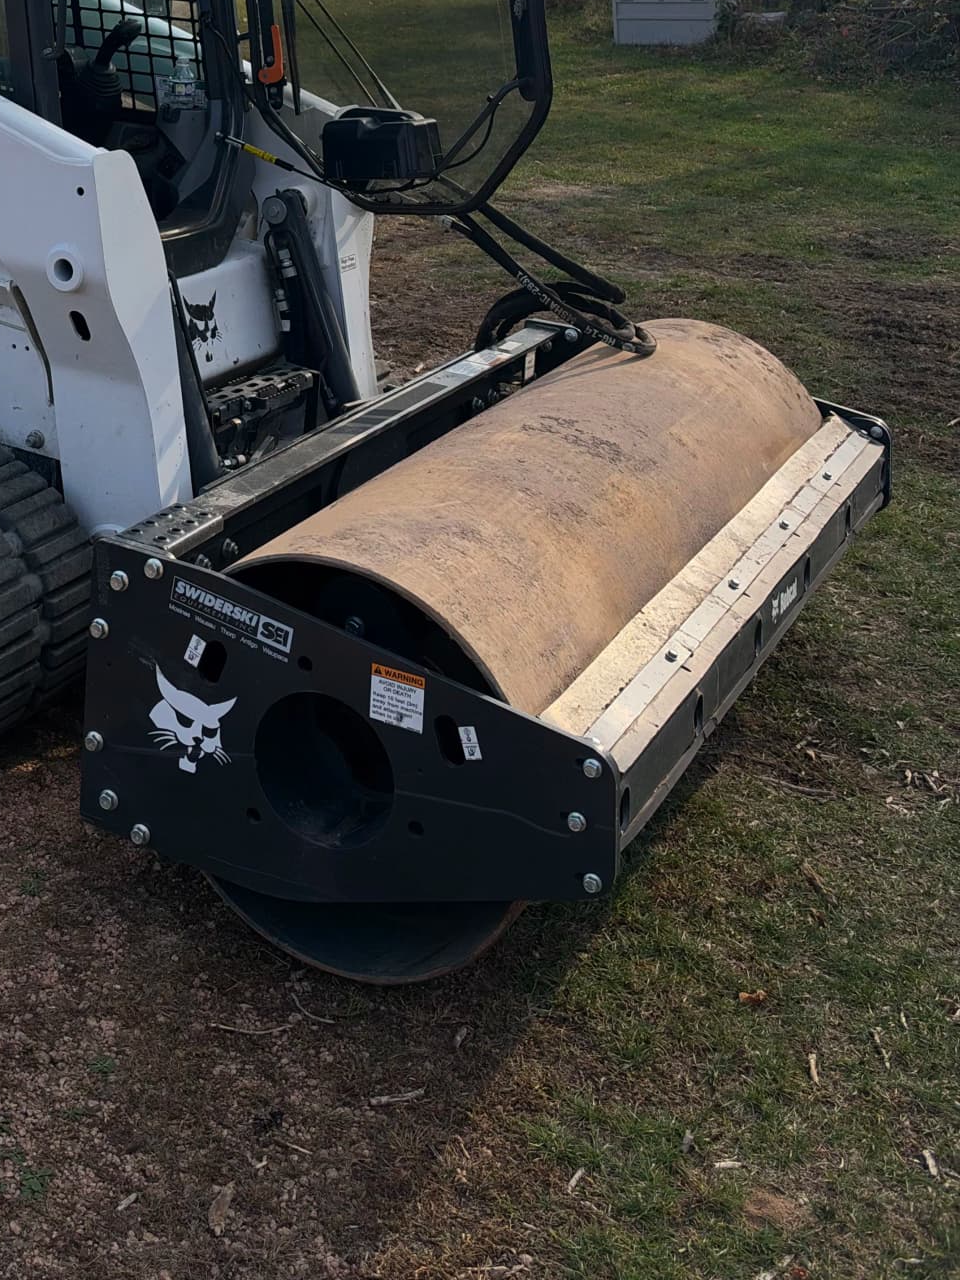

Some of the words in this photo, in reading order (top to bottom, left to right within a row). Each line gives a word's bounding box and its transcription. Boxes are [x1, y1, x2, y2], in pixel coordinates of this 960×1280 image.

[175, 580, 259, 627] SWIDERSKI
[260, 621, 290, 648] SEI
[220, 626, 237, 640] Thorp
[240, 636, 259, 650] Antigo
[384, 668, 423, 686] WARNING
[378, 679, 396, 688] AVOID
[396, 684, 417, 694] INJURY
[392, 689, 412, 698] DEATH
